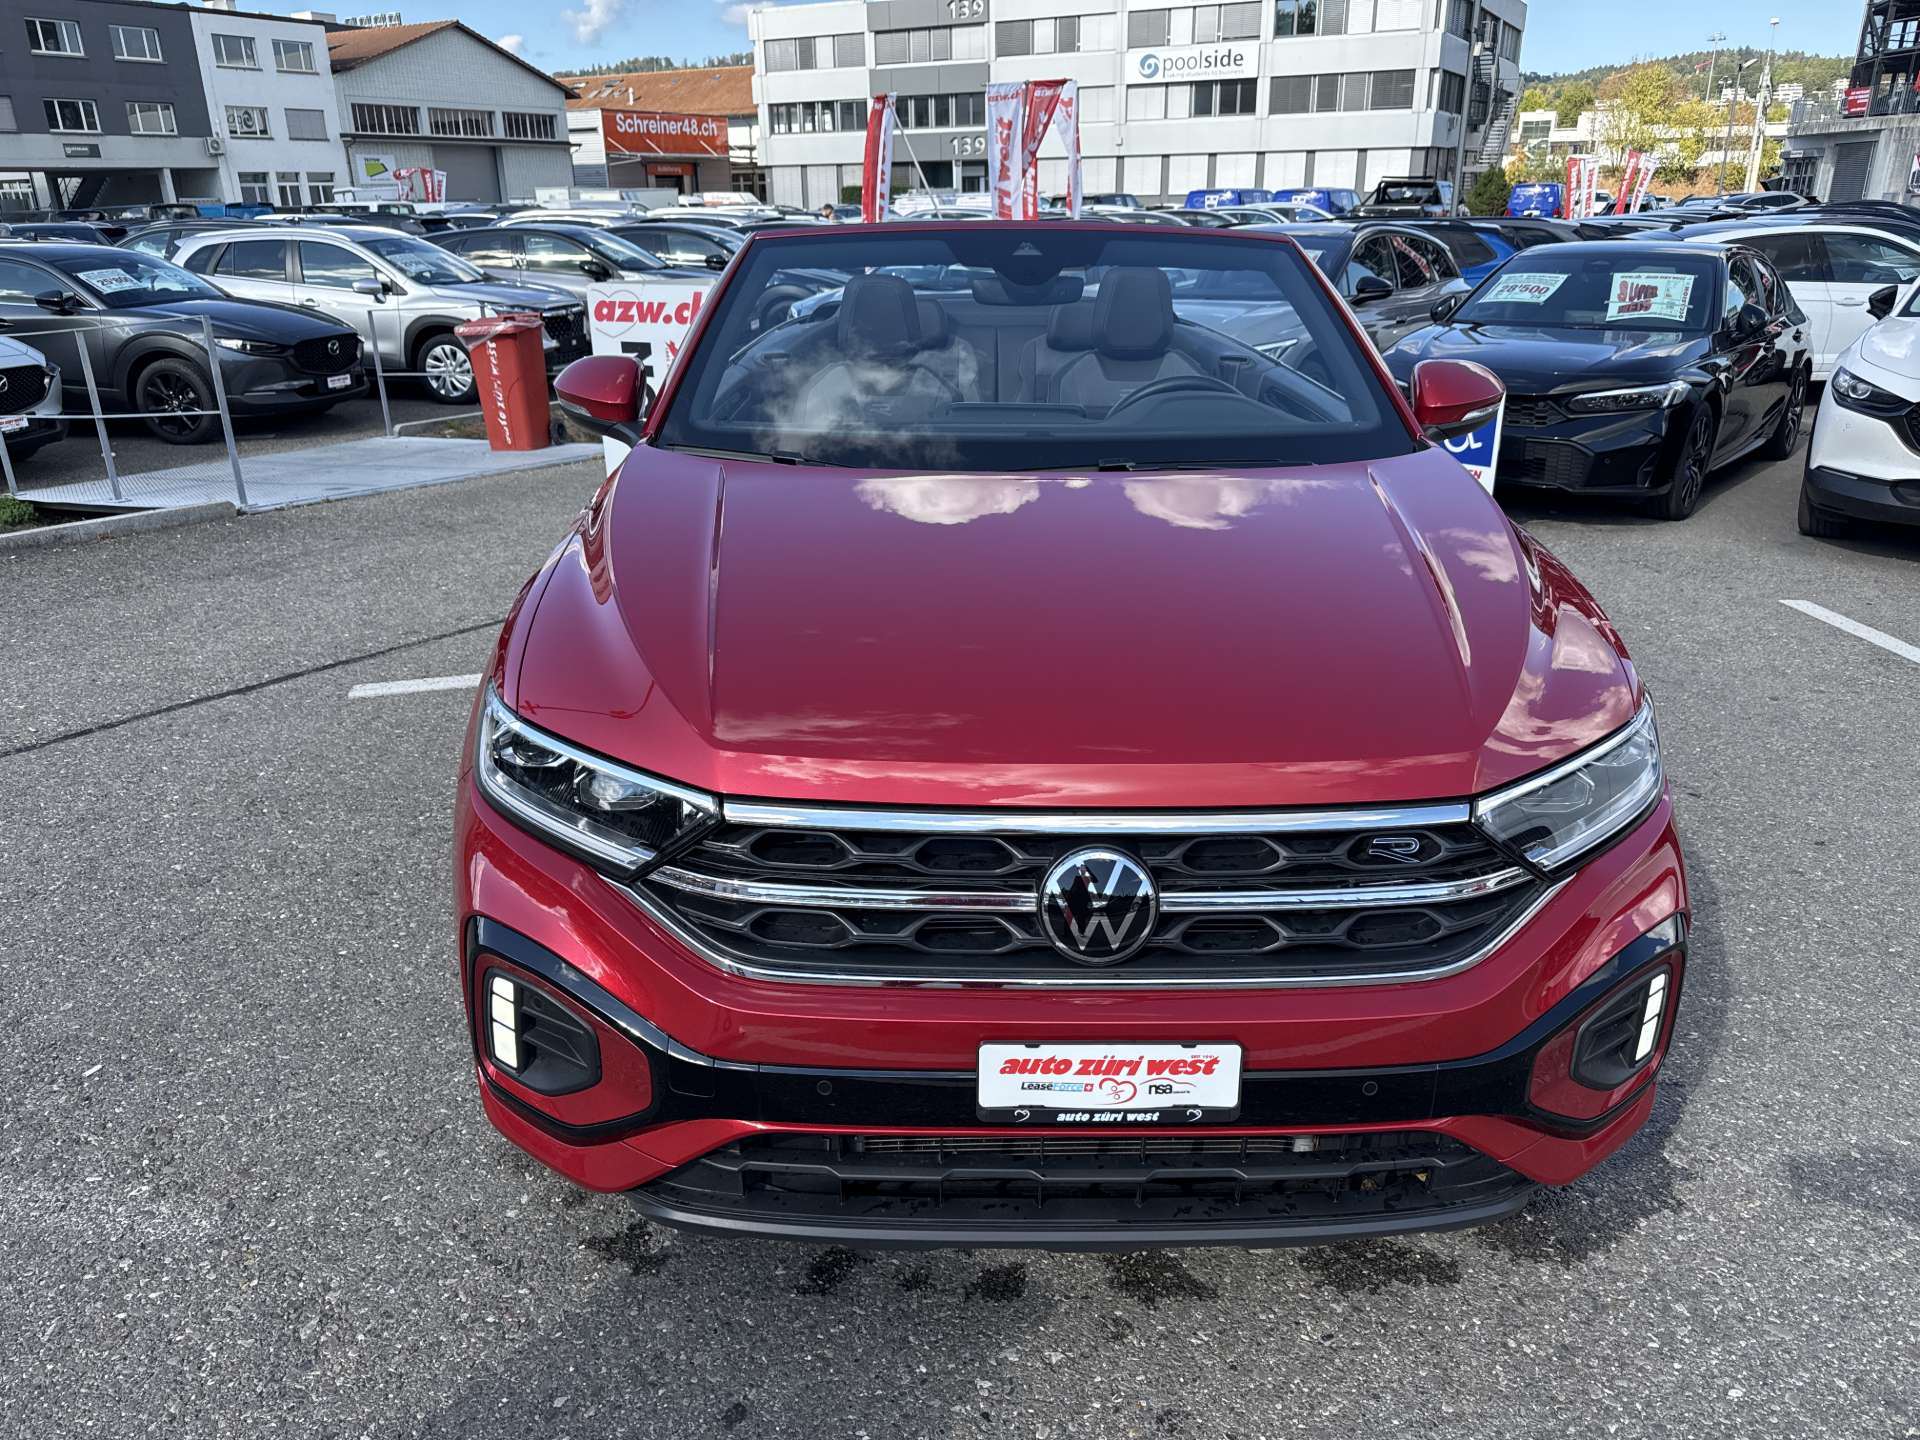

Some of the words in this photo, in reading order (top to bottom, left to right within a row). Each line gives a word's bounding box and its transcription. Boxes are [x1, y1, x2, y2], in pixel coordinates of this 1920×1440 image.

[948, 0, 984, 19] 139
[1163, 49, 1244, 78] poolside
[615, 113, 718, 136] Schreiner48.ch
[951, 136, 986, 156] 139
[1000, 1055, 1073, 1075] auto
[1073, 1055, 1144, 1076] züri
[1147, 1055, 1220, 1075] west
[1148, 1083, 1173, 1095] nsa
[1057, 1112, 1090, 1122] auto
[1091, 1111, 1123, 1122] züri
[1126, 1111, 1160, 1122] west
